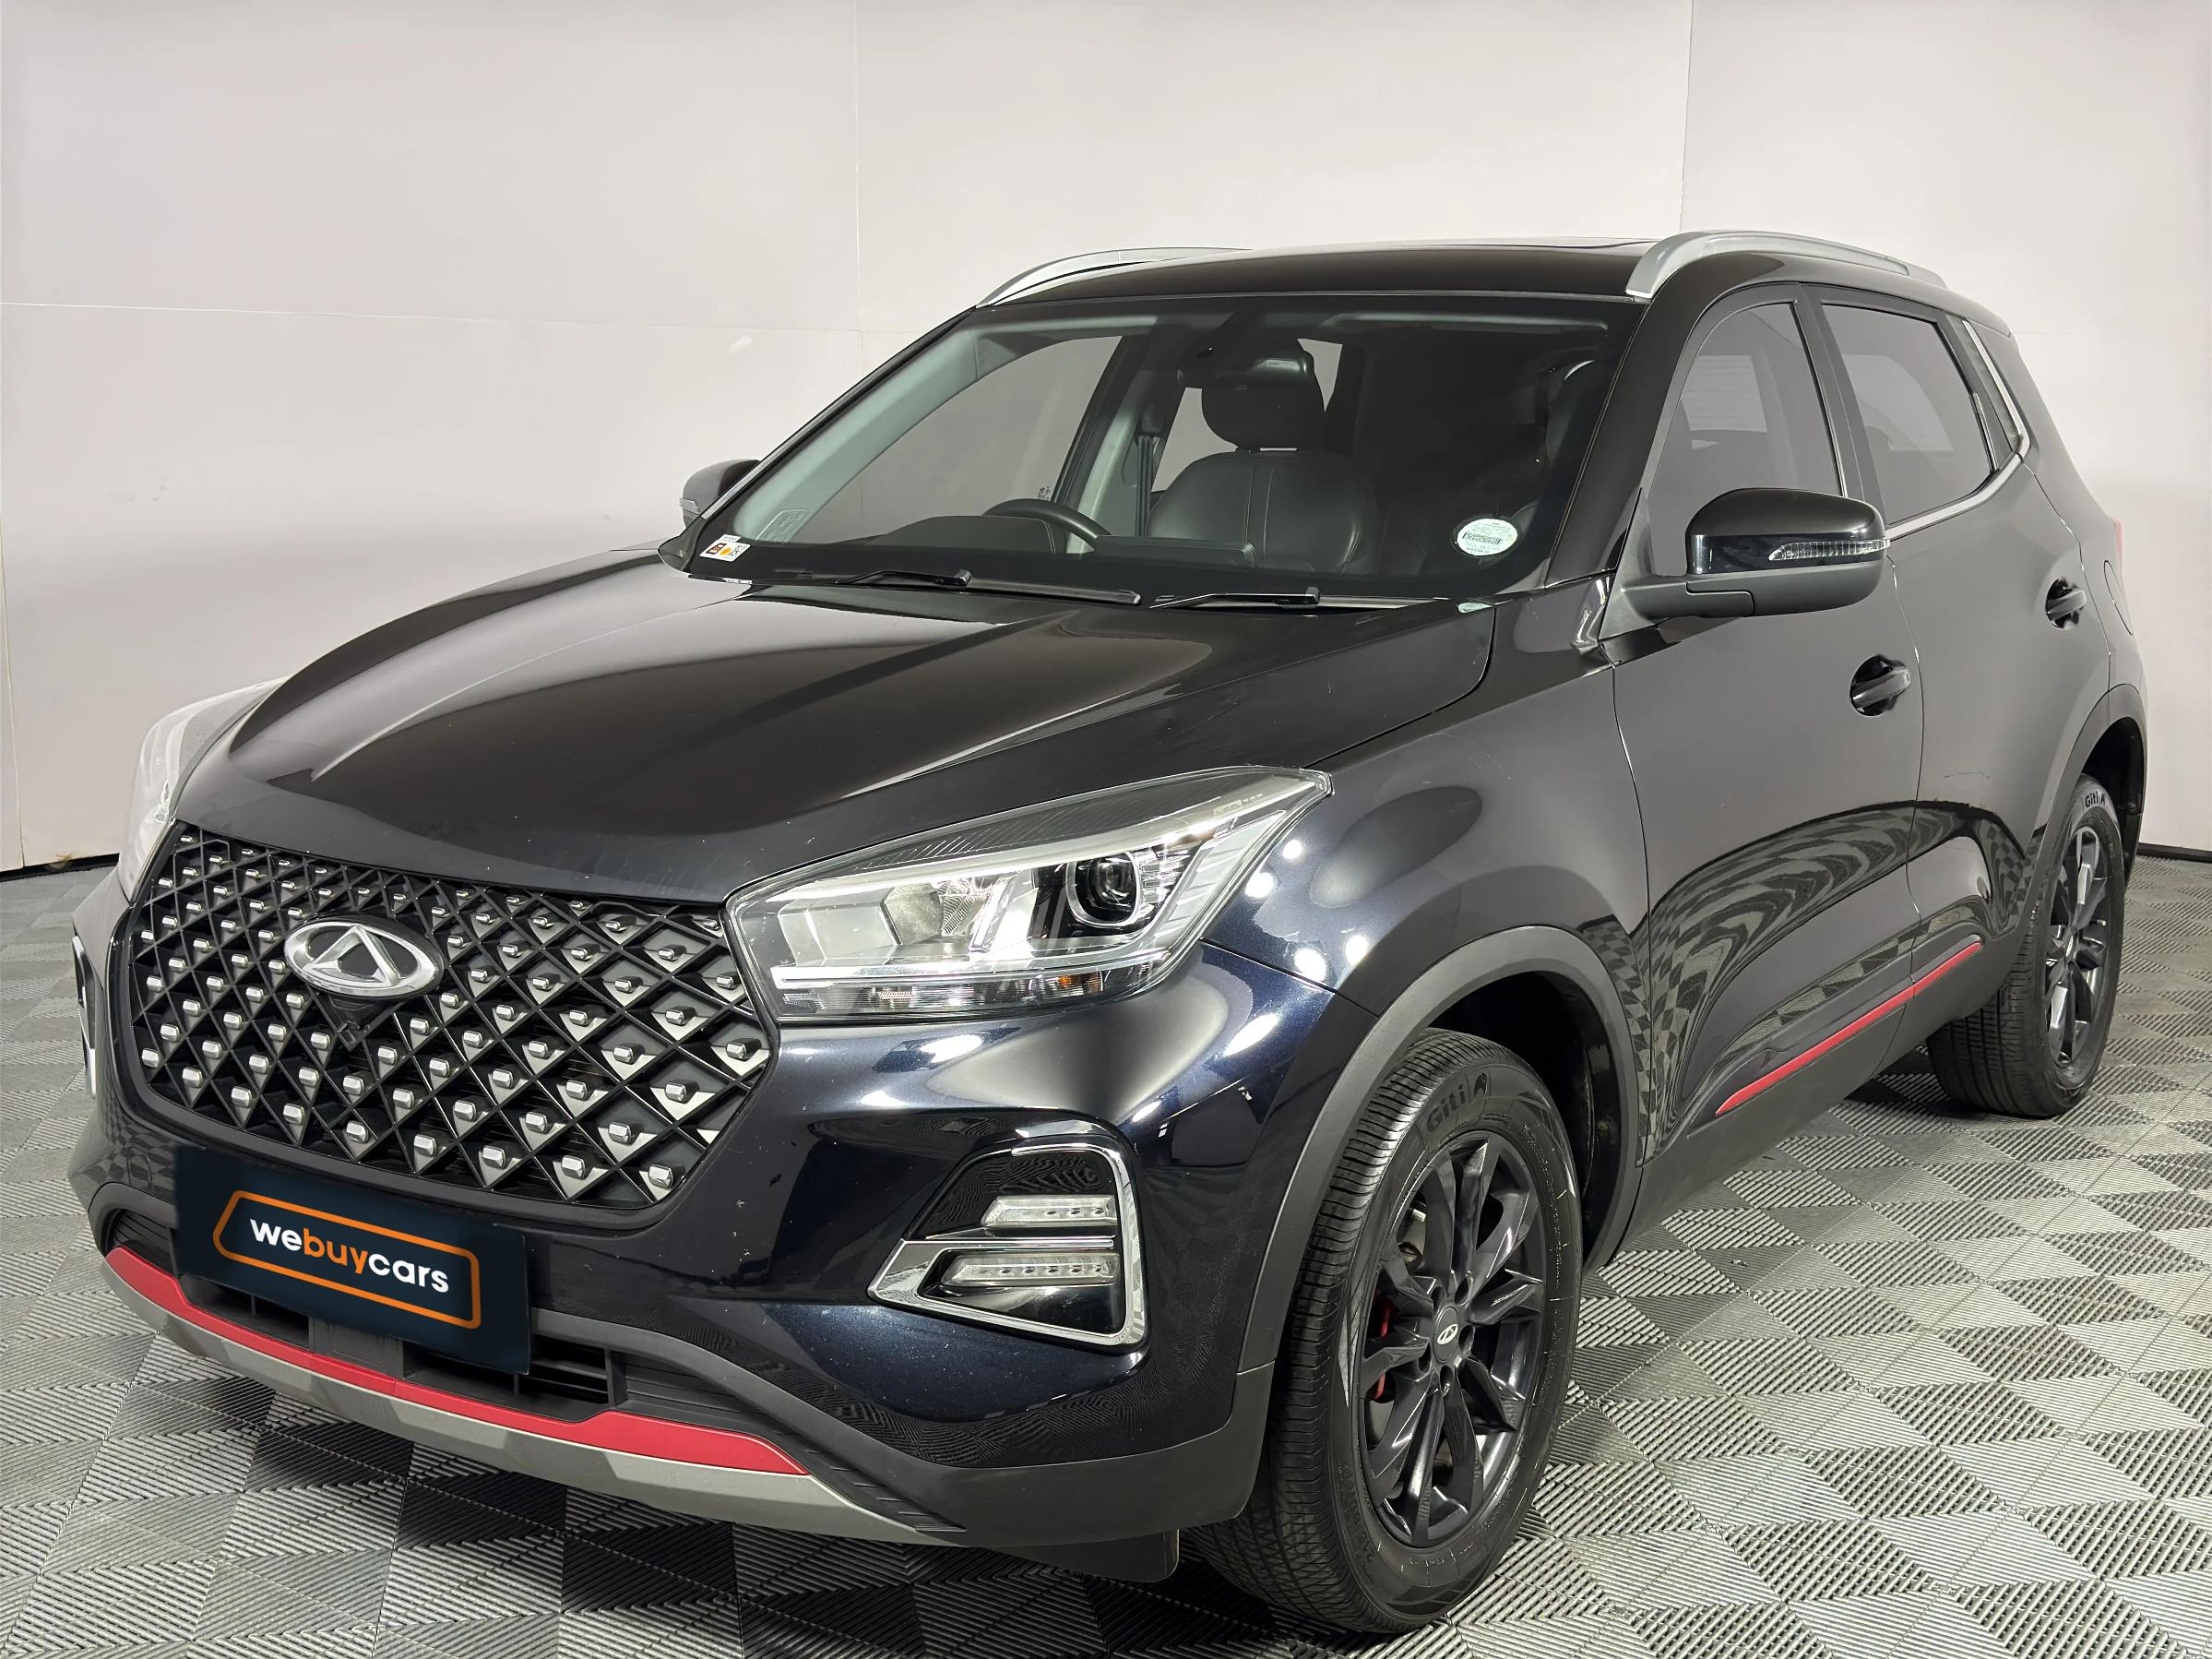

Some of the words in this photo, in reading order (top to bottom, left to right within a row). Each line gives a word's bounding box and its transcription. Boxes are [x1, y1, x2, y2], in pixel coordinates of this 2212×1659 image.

[2085, 792, 2099, 807] Giti
[1426, 1084, 1467, 1132] Giti
[249, 1219, 449, 1293] webuycars
